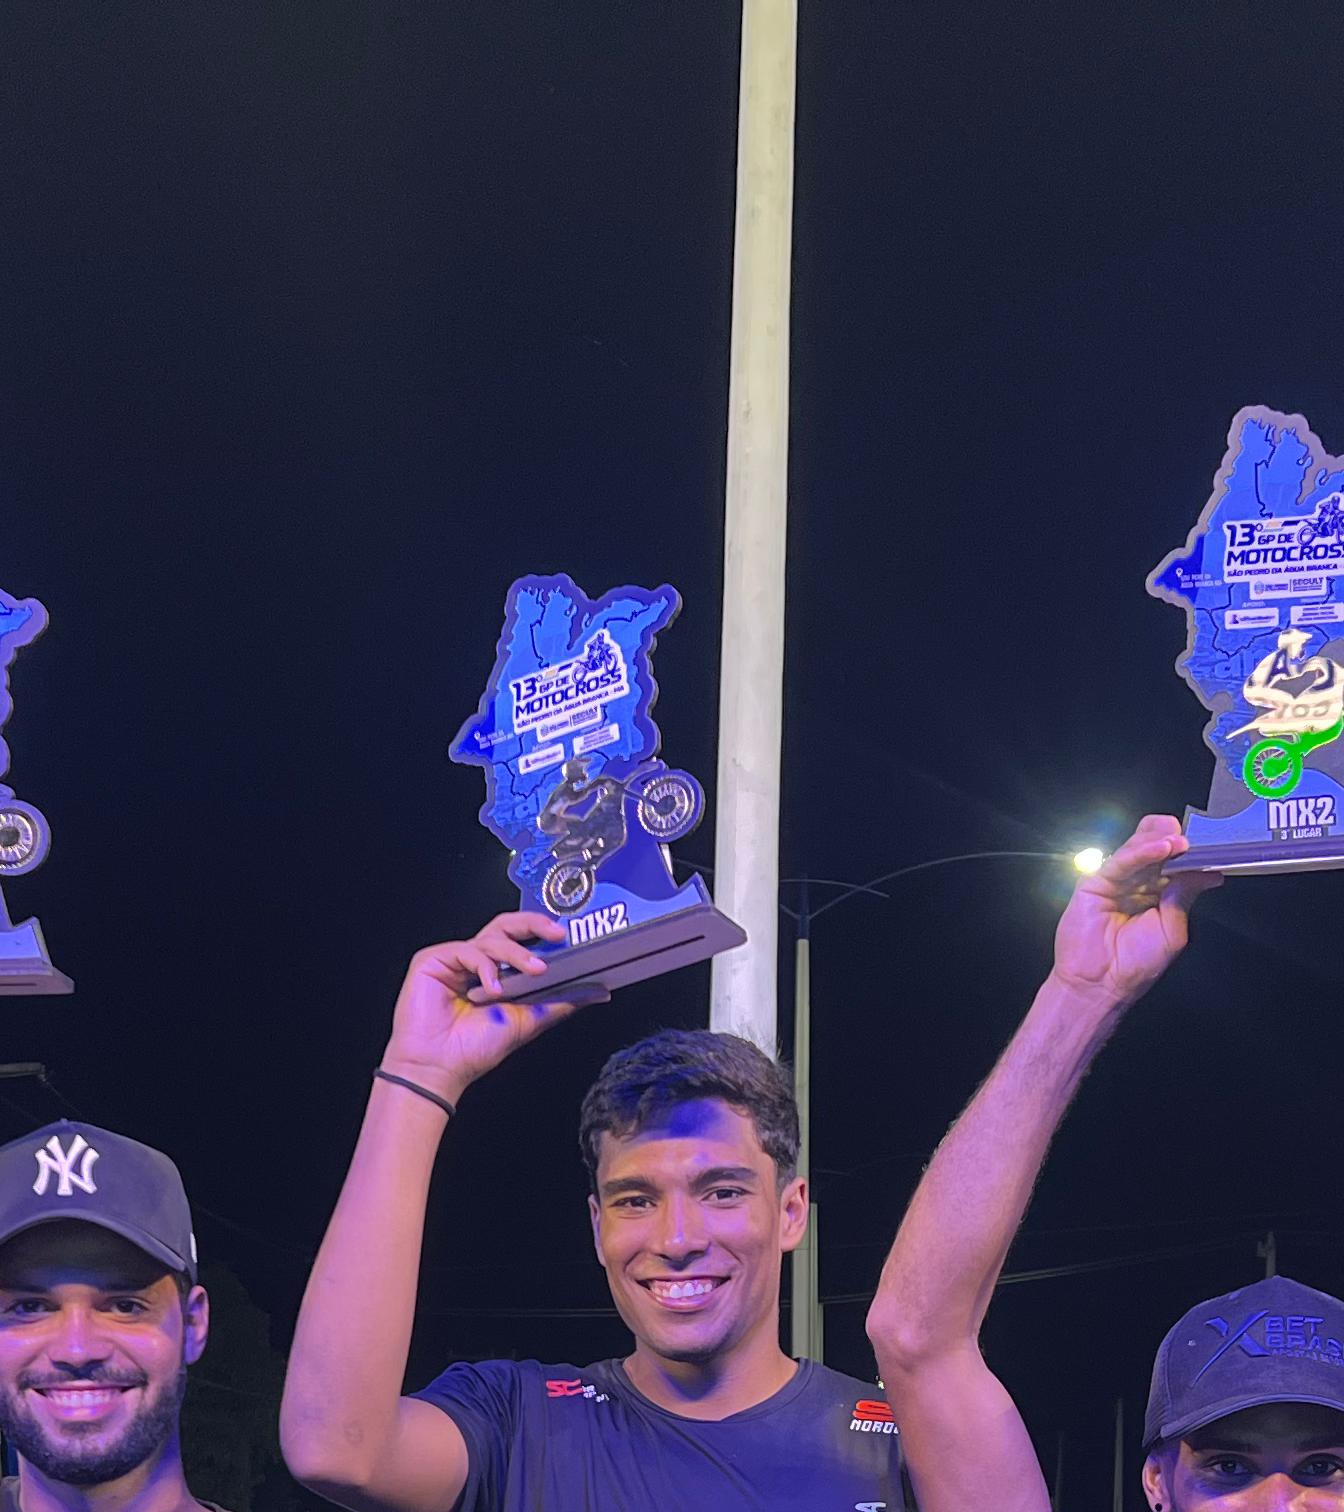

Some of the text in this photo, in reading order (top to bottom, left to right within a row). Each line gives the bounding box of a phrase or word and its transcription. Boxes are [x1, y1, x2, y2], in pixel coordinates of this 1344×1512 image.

[1258, 534, 1275, 545] GP
[1278, 533, 1295, 544] DE
[516, 672, 622, 719] MOTOCROSS
[1269, 796, 1334, 828] MX2
[1293, 828, 1322, 839] LUGAR
[570, 903, 628, 946] MX2
[32, 1134, 100, 1196] NY
[1264, 1315, 1324, 1334] BET
